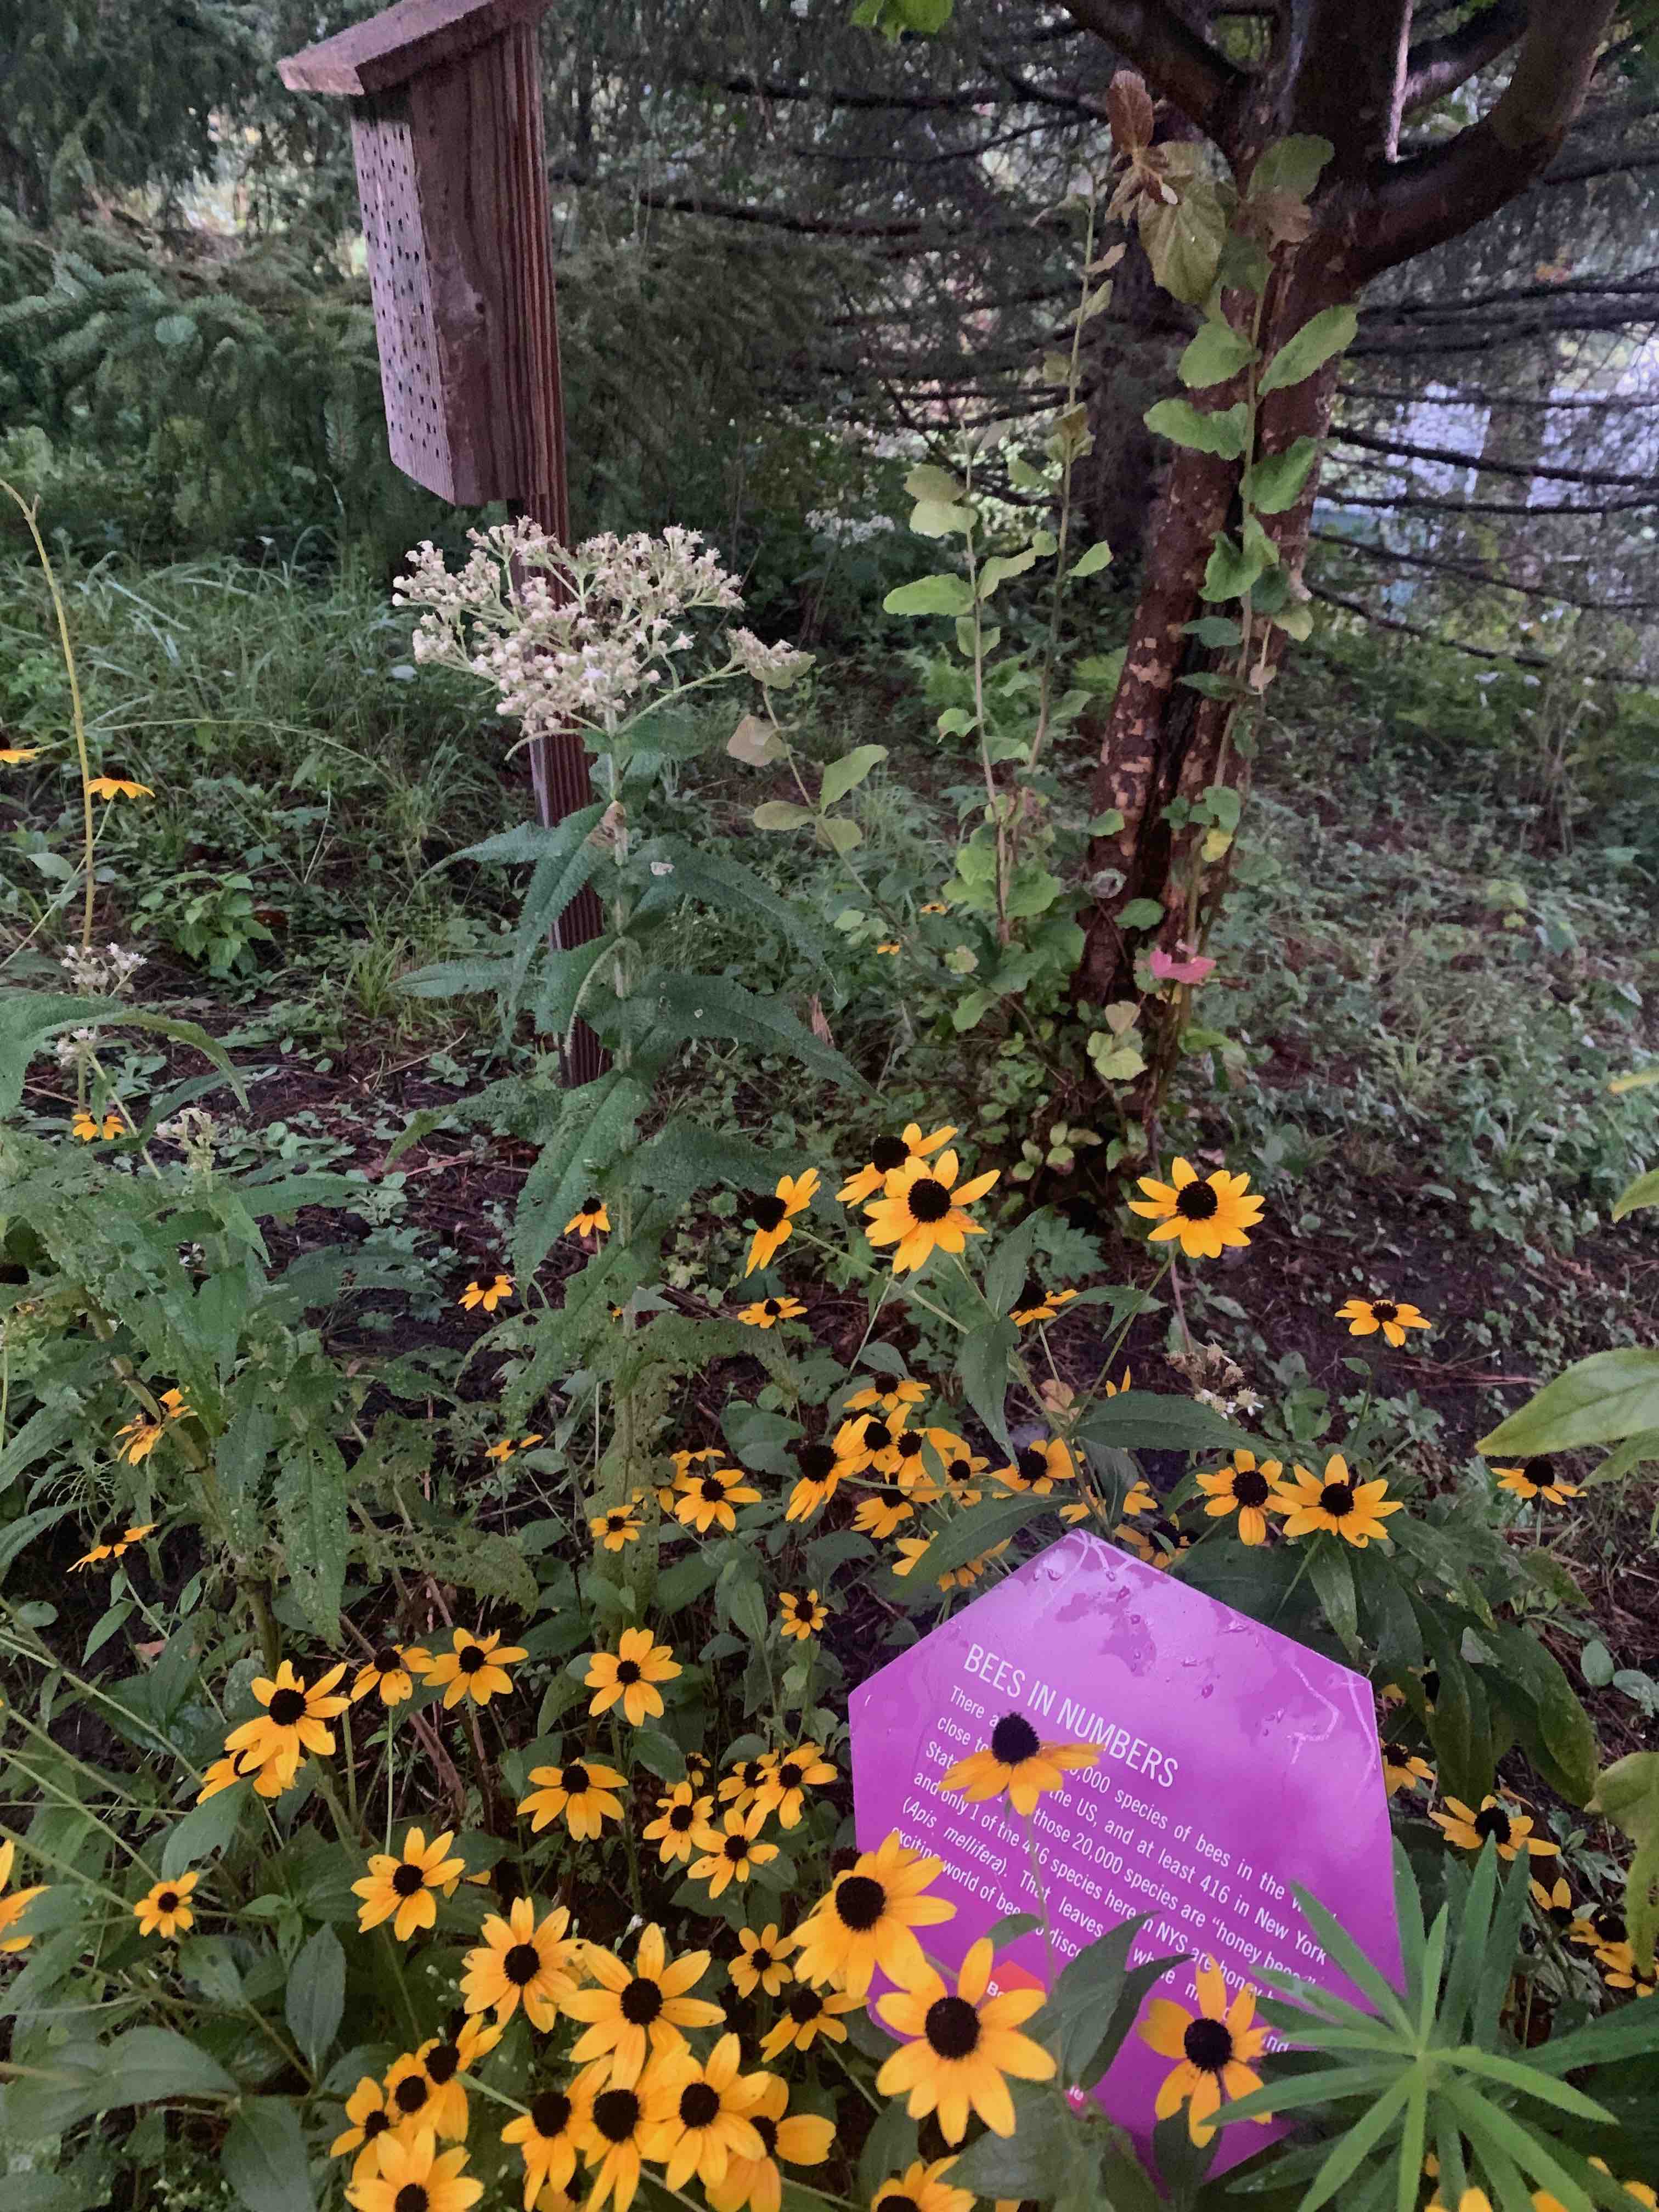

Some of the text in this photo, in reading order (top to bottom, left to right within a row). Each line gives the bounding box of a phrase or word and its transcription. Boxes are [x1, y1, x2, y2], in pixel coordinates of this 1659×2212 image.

[950, 1685, 1285, 1900] There ,000 species of bees in the
[963, 1643, 1178, 1787] BEES IN NUMBERS
[902, 1796, 938, 1829] (Apis
[943, 1826, 1007, 1878] mellifera).
[1058, 1895, 1104, 1938] leaves
[1133, 1947, 1176, 1984] whe
[913, 1772, 941, 1797] and
[940, 1790, 969, 1815] only
[969, 1804, 979, 1821] 1
[981, 1814, 998, 1832] of
[997, 1821, 1020, 1847] the
[1050, 1858, 1103, 1900] species
[1104, 1888, 1137, 1921] here
[1155, 1921, 1188, 1954] NYS
[1219, 1959, 1263, 1996] hony
[926, 1740, 1317, 1984] Stat those 20,000 species are “honey bee”
[937, 1717, 971, 1746] close
[1076, 1797, 1098, 1828] US,
[1104, 1819, 1135, 1846] and
[1136, 1839, 1155, 1859] at
[1158, 1847, 1196, 1884] least
[1199, 1874, 1231, 1904] 416
[1233, 1894, 1250, 1917] in
[1254, 1906, 1290, 1940] New
[1295, 1929, 1327, 1966] York
[942, 1859, 980, 1892] world
[979, 1885, 997, 1903] of
[996, 1891, 1021, 1916] bee
